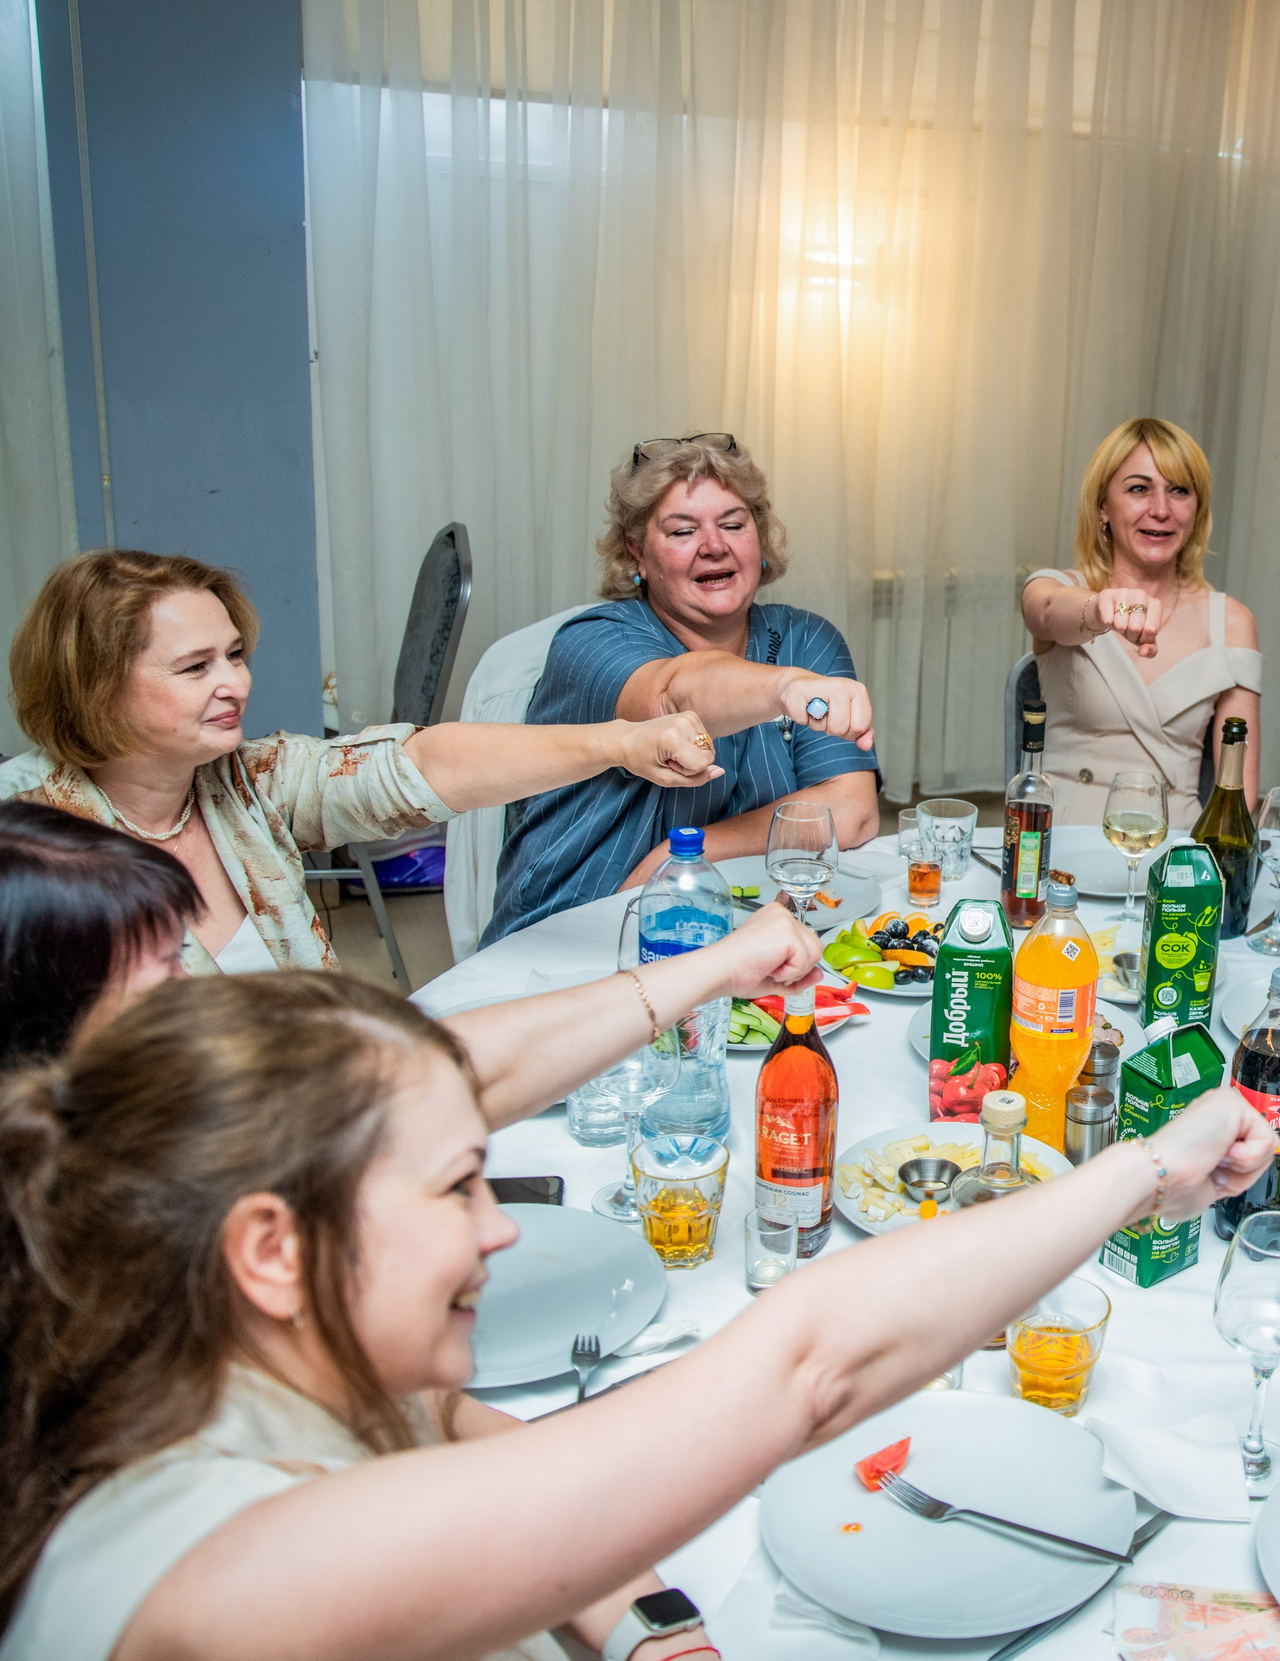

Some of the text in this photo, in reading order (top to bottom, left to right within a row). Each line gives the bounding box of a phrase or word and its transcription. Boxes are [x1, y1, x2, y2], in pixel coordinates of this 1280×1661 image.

[1161, 944, 1190, 953] СОК
[974, 971, 1003, 981] 100%
[943, 966, 972, 1048] Добрый
[756, 1181, 810, 1197] ARMENIAN COGNAC
[772, 1193, 788, 1208] 12
